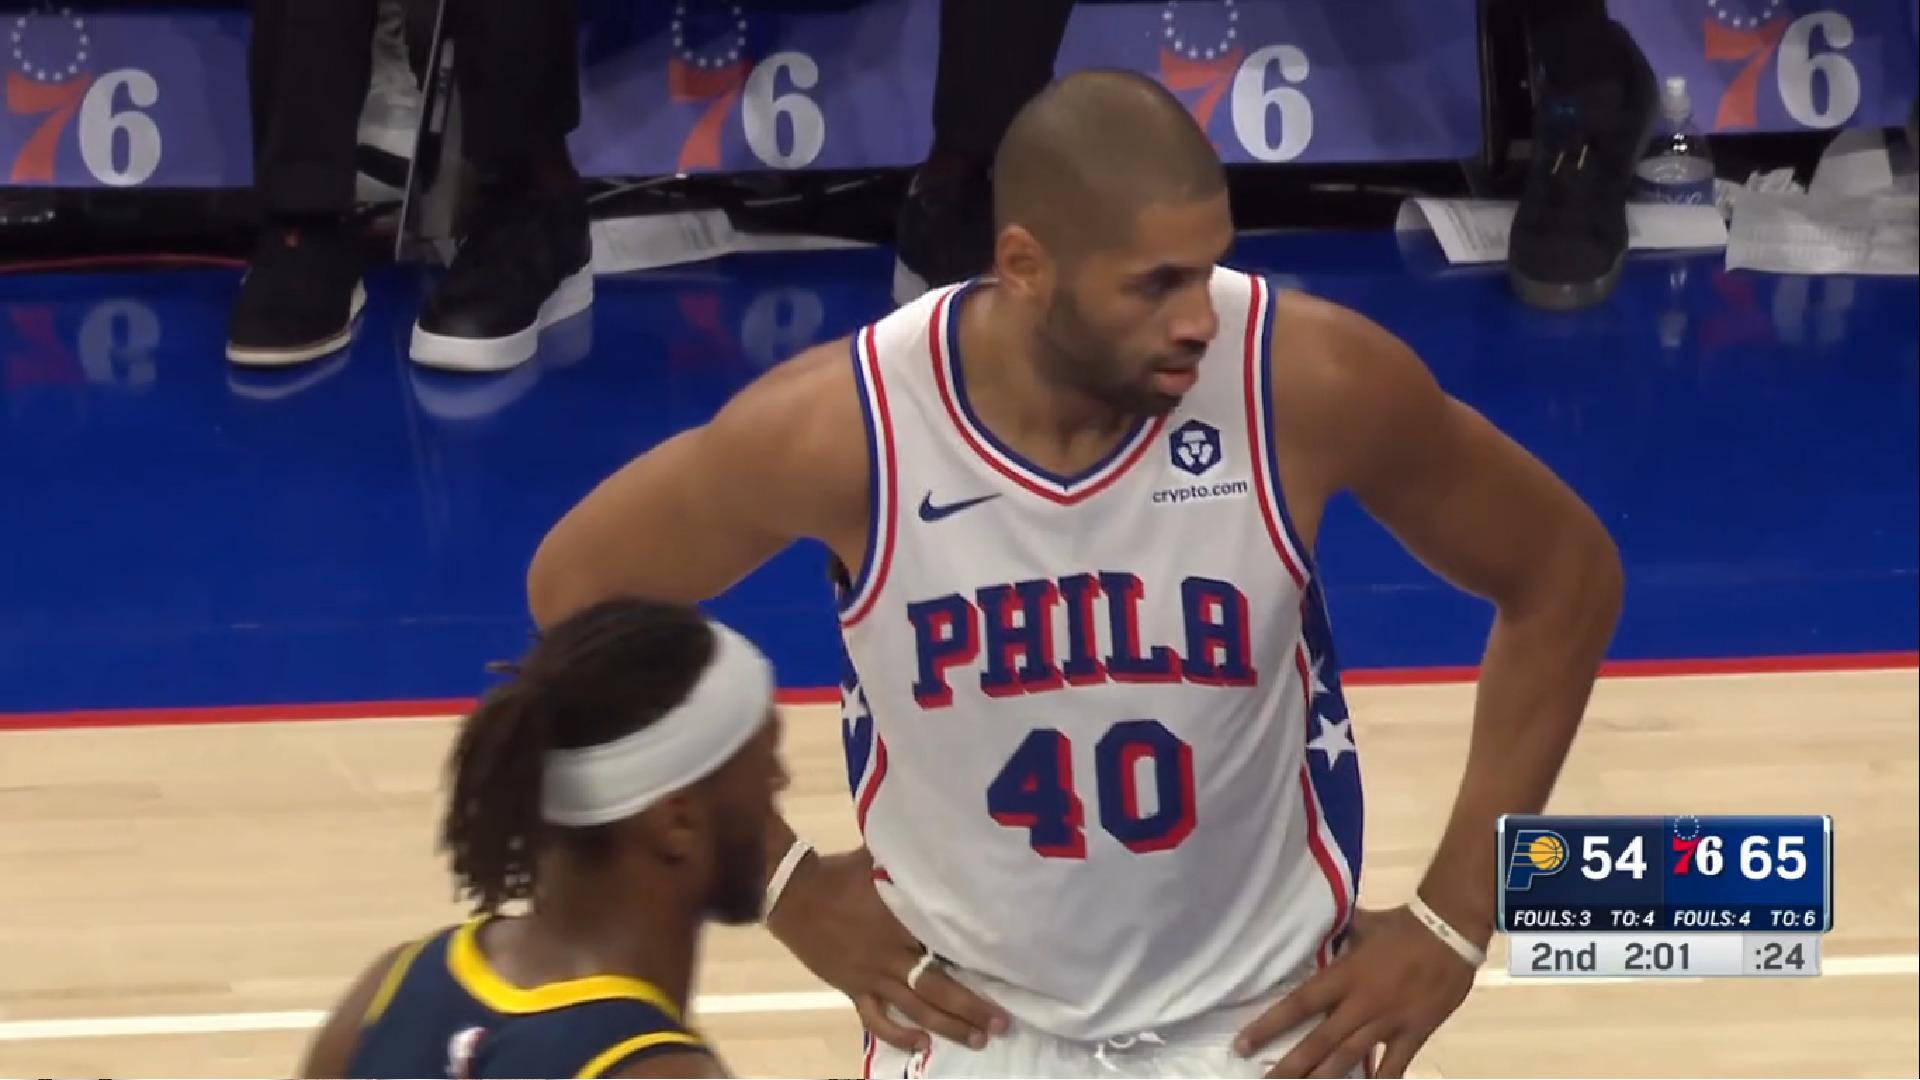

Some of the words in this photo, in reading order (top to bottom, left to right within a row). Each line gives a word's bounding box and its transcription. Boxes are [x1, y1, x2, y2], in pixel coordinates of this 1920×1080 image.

[6, 68, 162, 186] 76
[668, 51, 825, 170] 76
[1160, 43, 1314, 163] 76
[1704, 11, 1860, 129] 76
[1152, 480, 1248, 503] crypto.com
[907, 570, 1258, 710] PHILA
[987, 719, 1197, 859] 40
